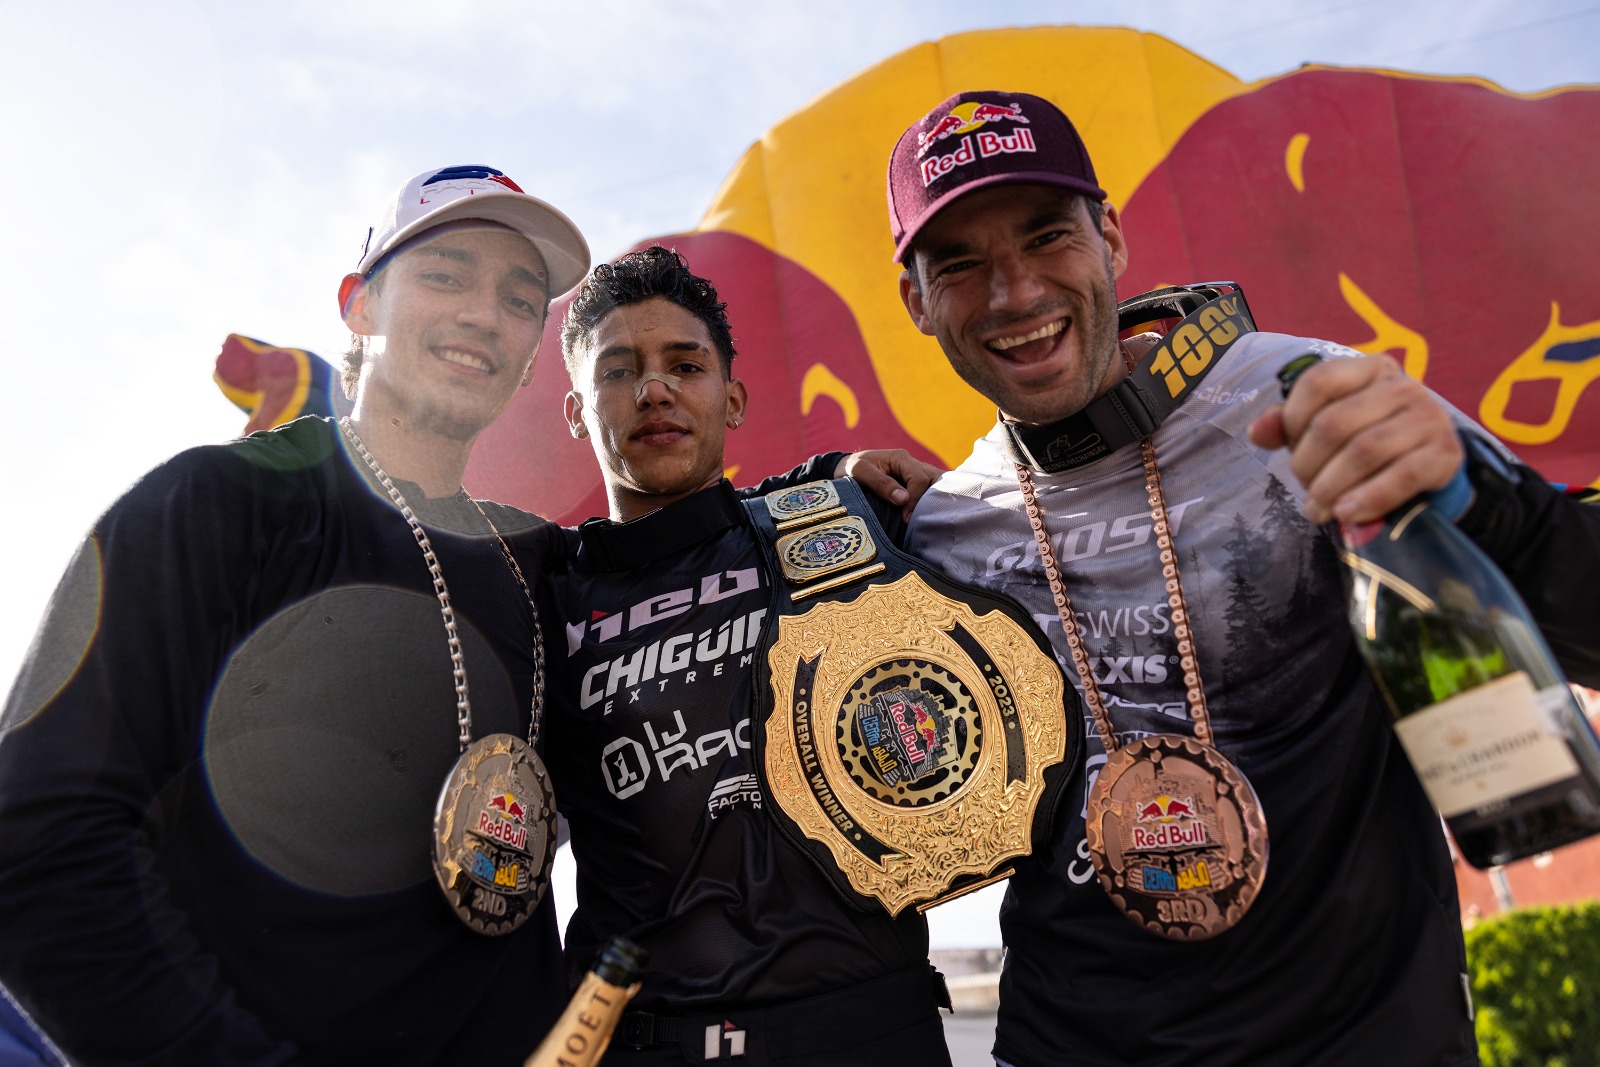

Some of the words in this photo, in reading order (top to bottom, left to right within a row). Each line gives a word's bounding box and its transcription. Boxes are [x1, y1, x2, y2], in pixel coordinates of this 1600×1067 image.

[921, 135, 976, 187] Red
[976, 128, 1036, 158] Bull
[986, 497, 1204, 577] GHOST
[1074, 603, 1173, 639] SWISS
[988, 675, 1016, 717] 2023
[889, 701, 915, 736] Red
[901, 730, 926, 764] Bull
[795, 700, 816, 773] OVERALL
[810, 773, 854, 833] WINNER
[479, 810, 504, 839] Red
[503, 823, 527, 850] Bull
[1134, 825, 1170, 849] Red
[1168, 822, 1206, 845] Bull
[471, 887, 508, 917] 2ND
[1157, 899, 1207, 923] 3RD
